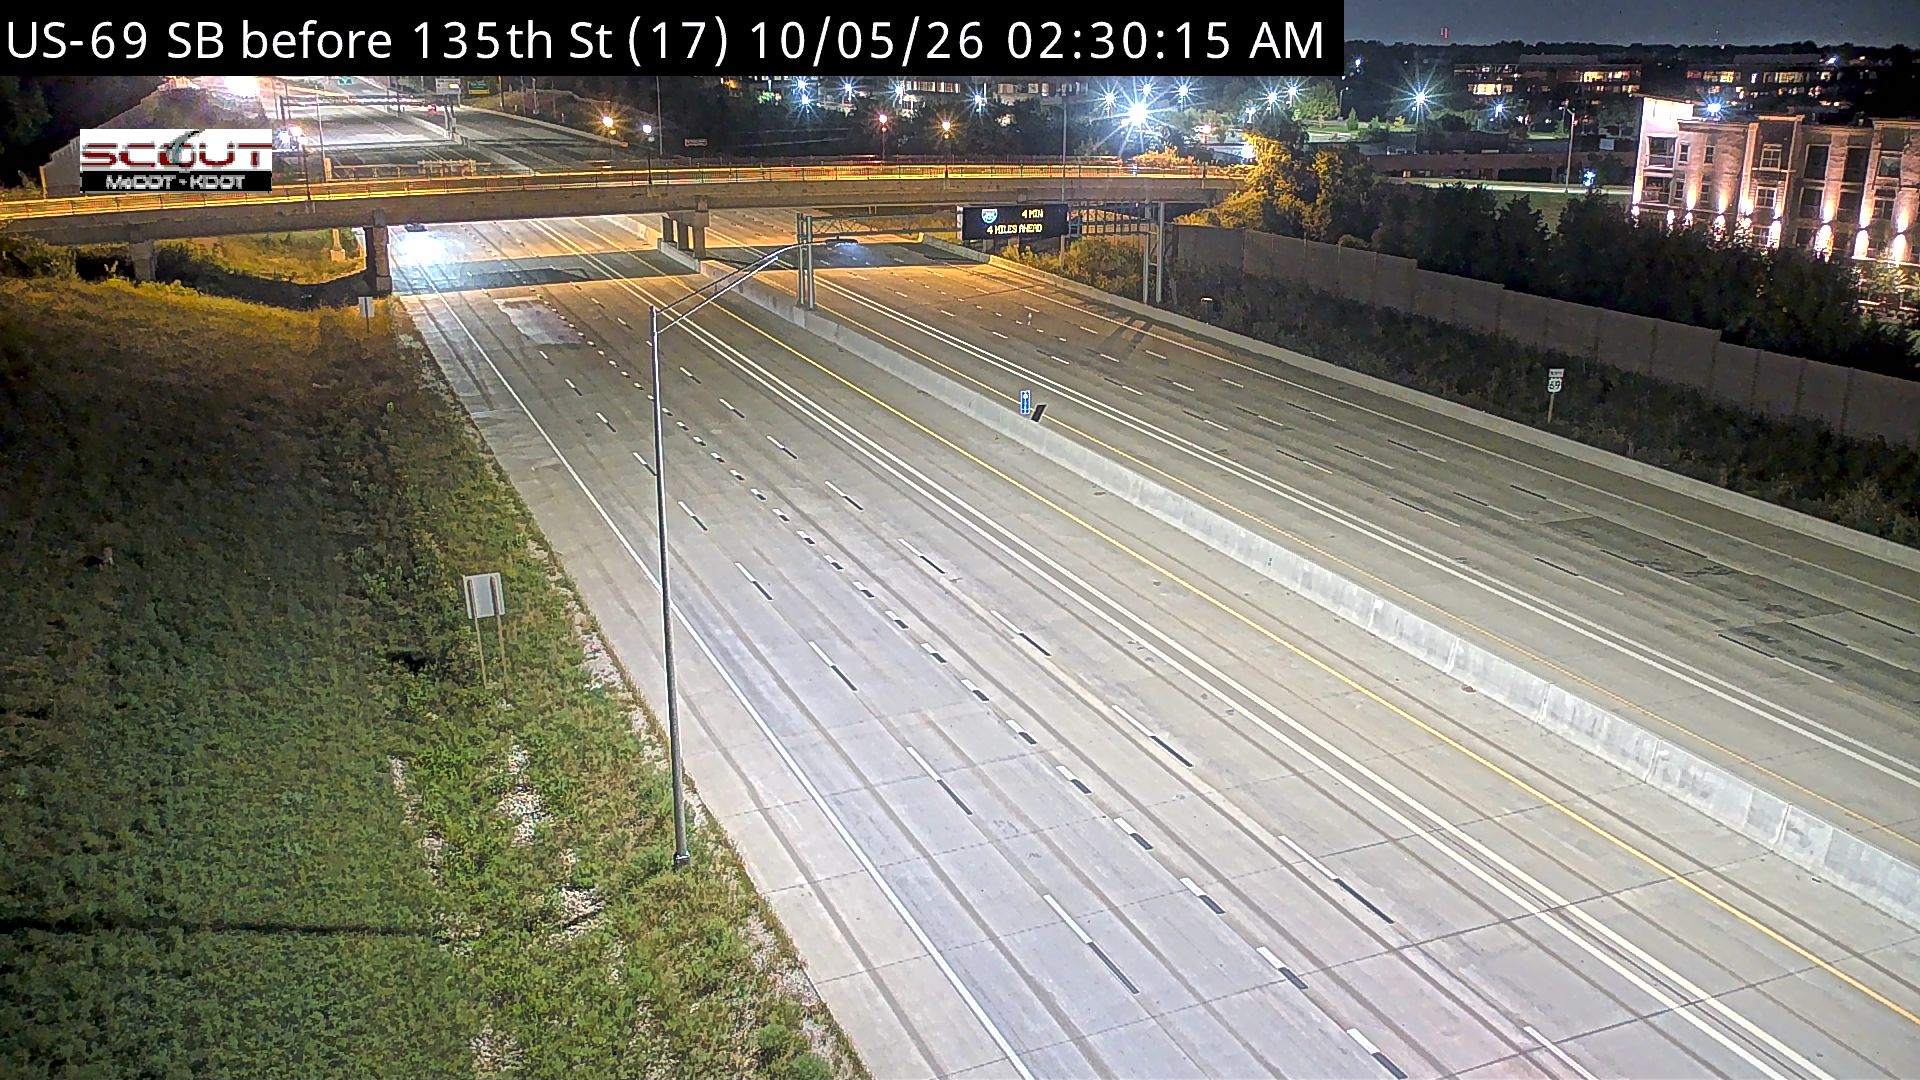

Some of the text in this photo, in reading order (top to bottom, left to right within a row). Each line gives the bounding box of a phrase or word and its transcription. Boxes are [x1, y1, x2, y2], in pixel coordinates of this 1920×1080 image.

[1021, 208, 1044, 219] 4 MIN
[986, 223, 1043, 235] 4 MILES AHEAD
[1549, 380, 1561, 390] 69
